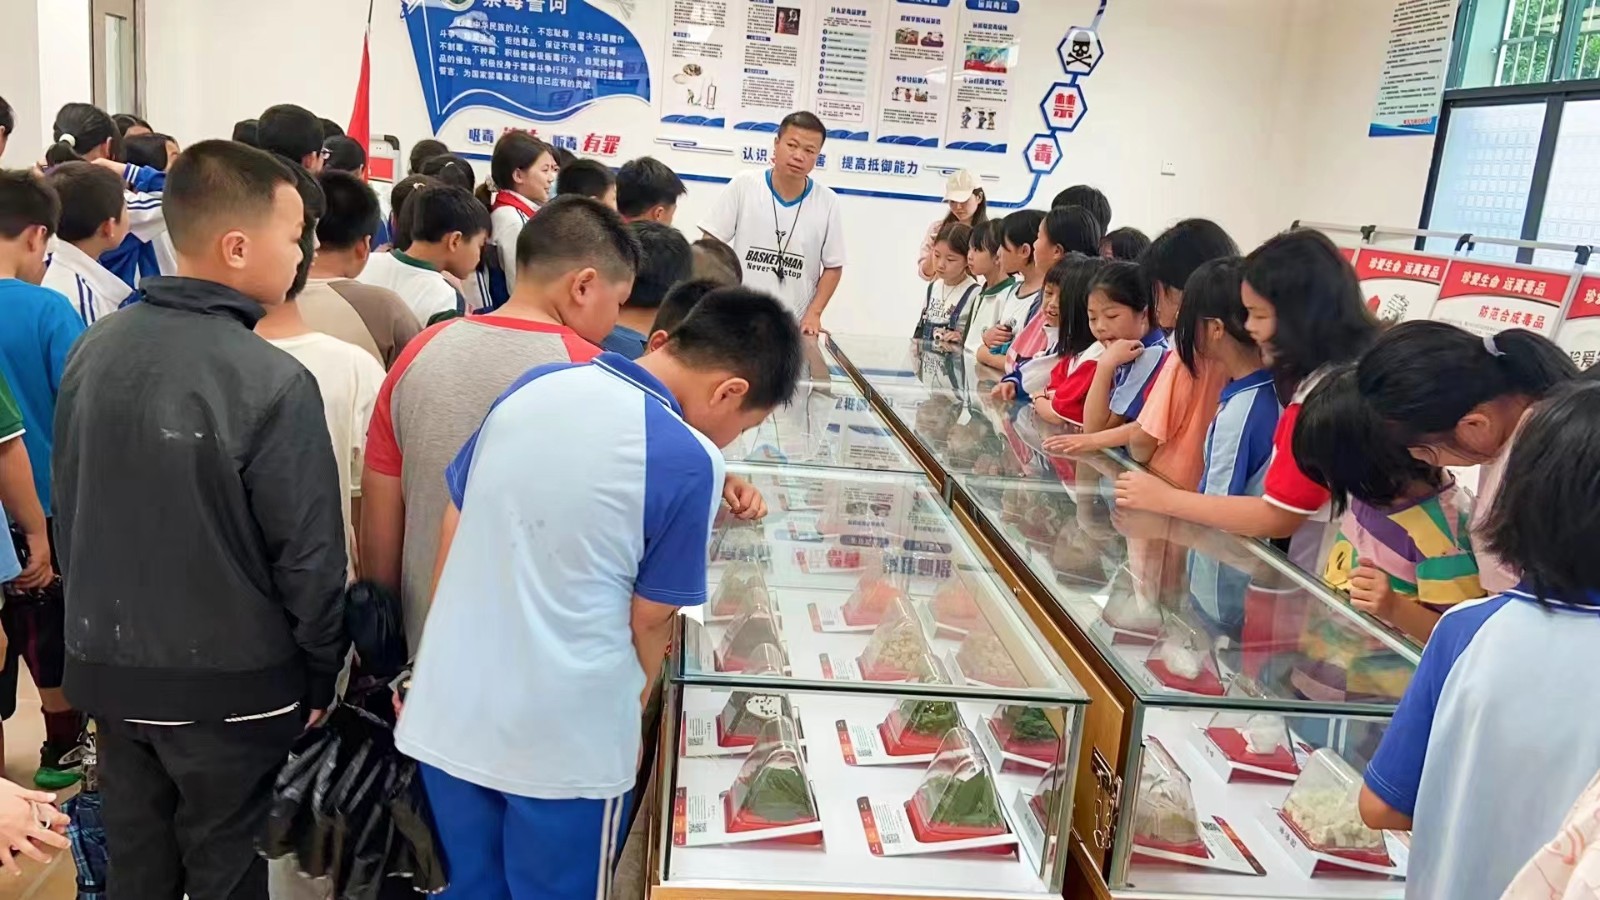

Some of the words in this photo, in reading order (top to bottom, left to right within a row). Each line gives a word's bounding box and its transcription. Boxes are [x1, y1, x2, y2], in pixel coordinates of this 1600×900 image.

[1053, 93, 1076, 118] 禁
[468, 128, 494, 143] 吸毒
[552, 135, 577, 150] 贩毒
[583, 133, 621, 154] 有罪
[742, 147, 768, 161] 认识
[841, 155, 919, 175] 提高抵御能力
[1034, 143, 1053, 165] 毒
[747, 262, 770, 273] Never
[784, 270, 802, 280] stop
[1368, 257, 1402, 273] 珍爱生命
[1403, 262, 1440, 279] 远离毒品
[1461, 270, 1500, 289] 珍爱生命
[1502, 276, 1547, 297] 远离毒品
[1479, 305, 1546, 329] 防范合成毒品
[1570, 350, 1600, 368] 珍爱
